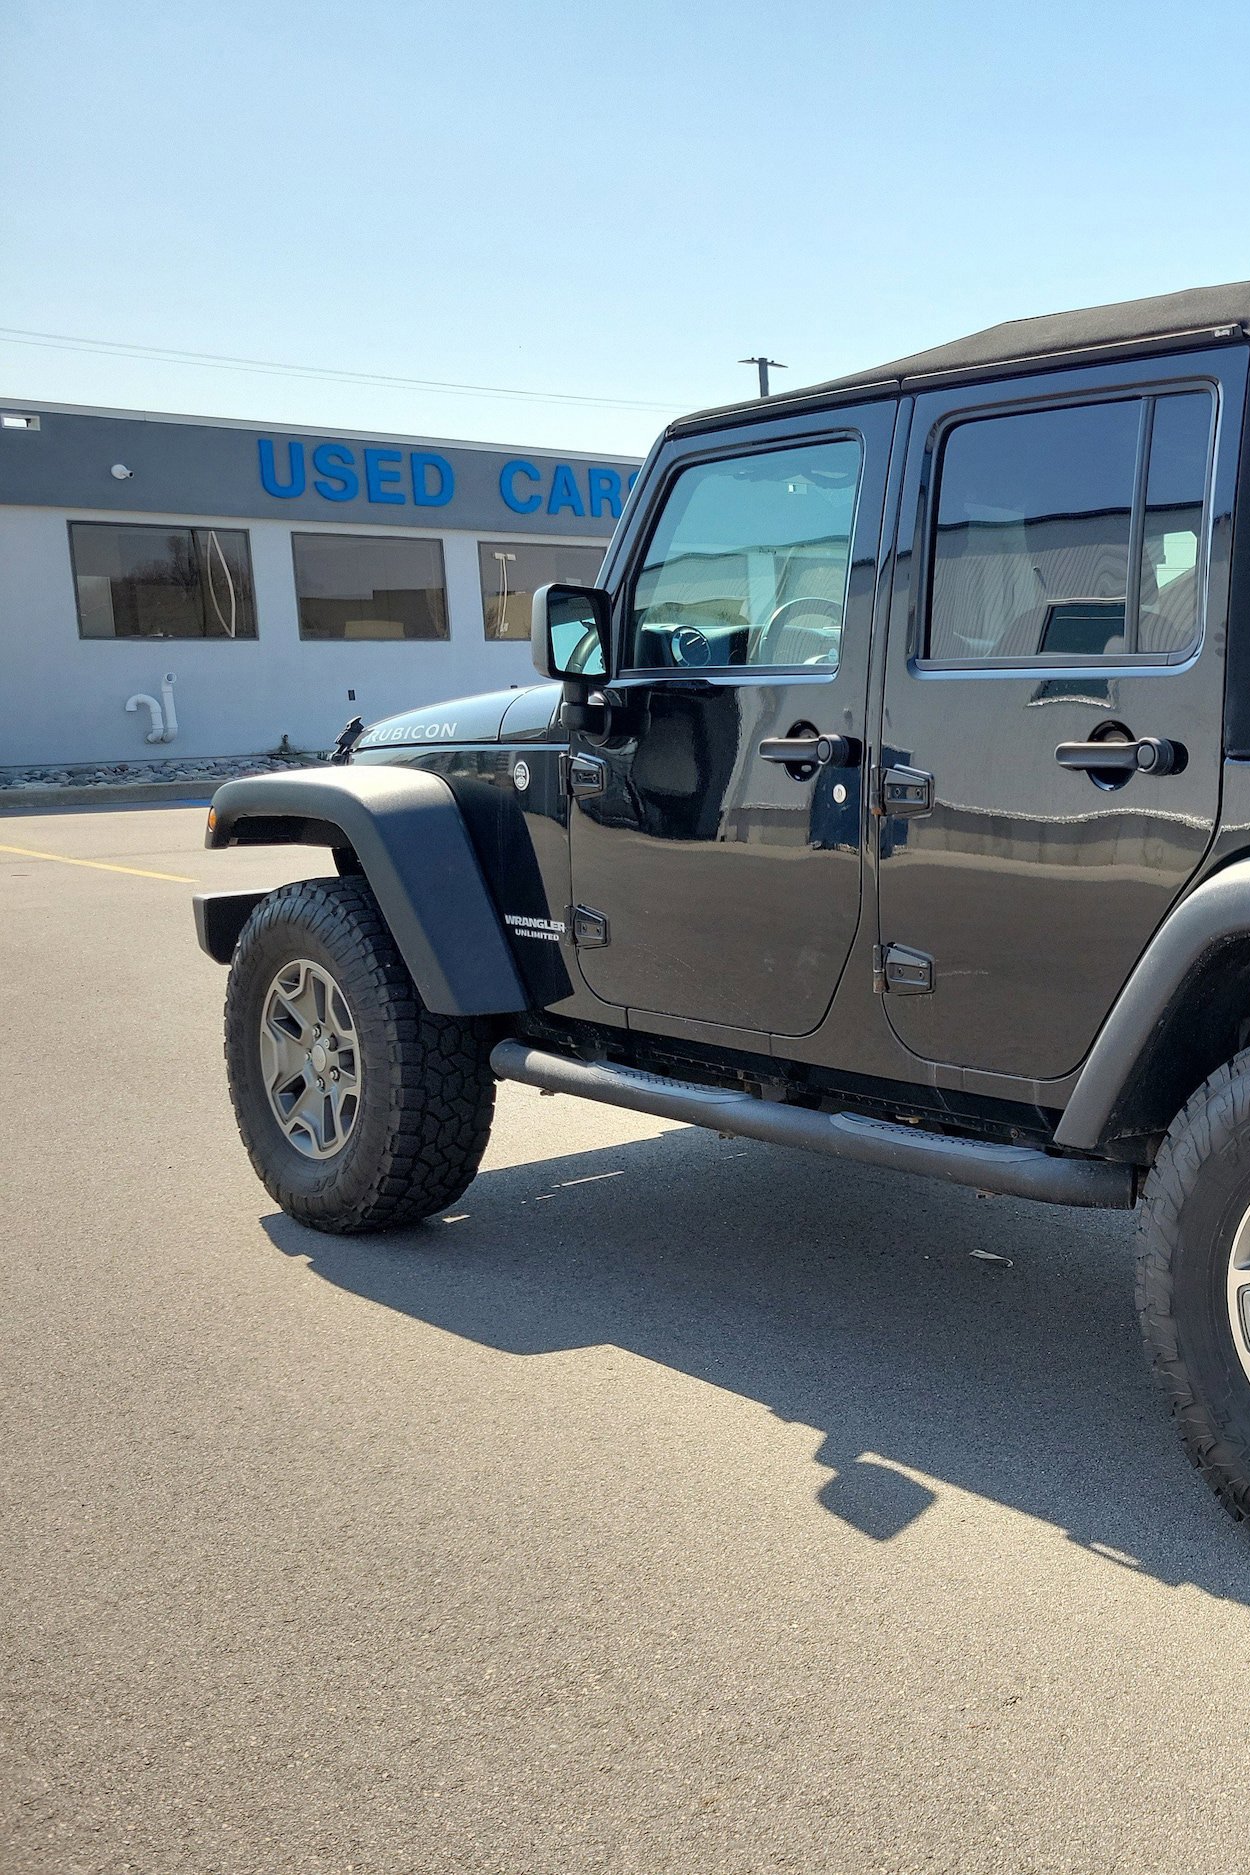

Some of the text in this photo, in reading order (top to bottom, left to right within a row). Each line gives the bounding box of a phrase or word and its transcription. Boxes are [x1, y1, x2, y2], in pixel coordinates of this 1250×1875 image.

[258, 438, 639, 519] USED CAR
[367, 722, 457, 743] RUBICON
[504, 914, 566, 933] WRANGLER
[515, 928, 559, 941] UNLIMITED
